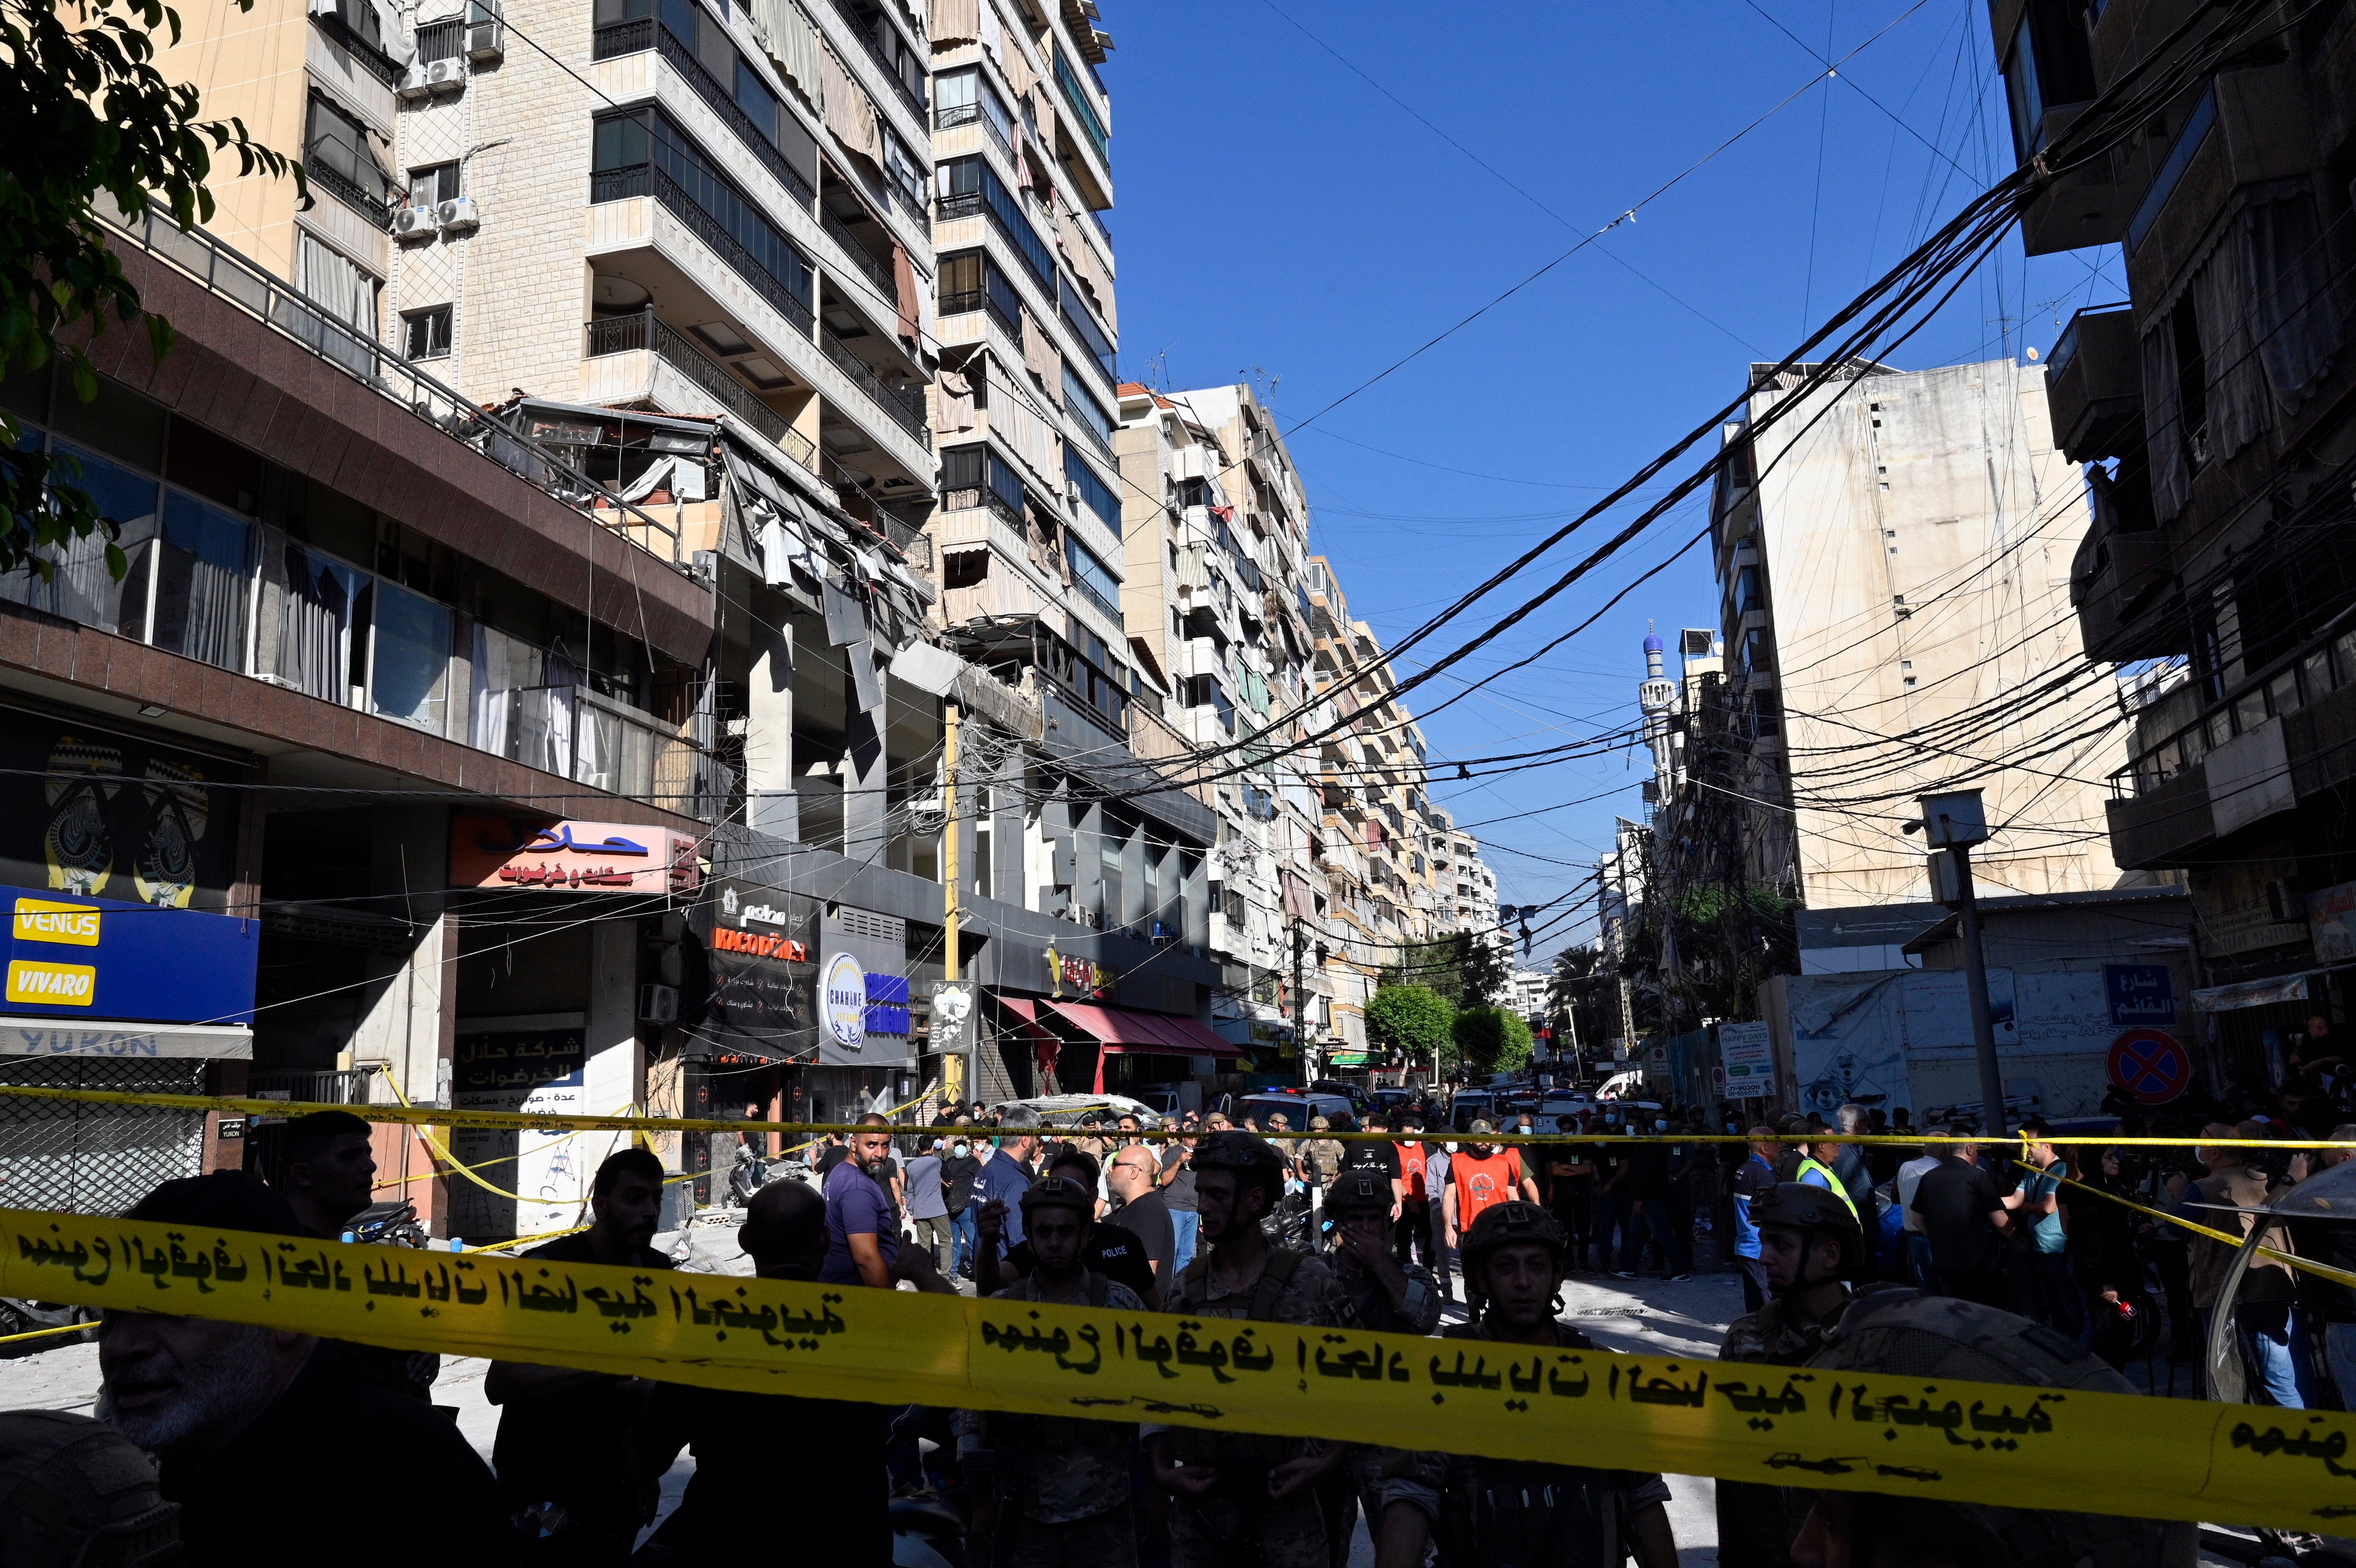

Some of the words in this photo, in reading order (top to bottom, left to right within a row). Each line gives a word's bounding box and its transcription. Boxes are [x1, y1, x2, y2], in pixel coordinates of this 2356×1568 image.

[19, 908, 96, 936] VENUS
[741, 904, 785, 928] مطعم
[18, 970, 89, 997] VIVARO
[2120, 969, 2158, 992] شارع
[830, 989, 862, 1009] CHAHINE
[2116, 996, 2171, 1021] القائم
[19, 1029, 157, 1056] YUKON
[514, 1037, 580, 1059] شركة
[1722, 1034, 1746, 1043] HAPPY
[468, 1064, 571, 1087] للخرضوات
[460, 1096, 498, 1106] مسكات
[508, 1093, 544, 1107] صواريخ
[1102, 1245, 1127, 1259] POLICE
